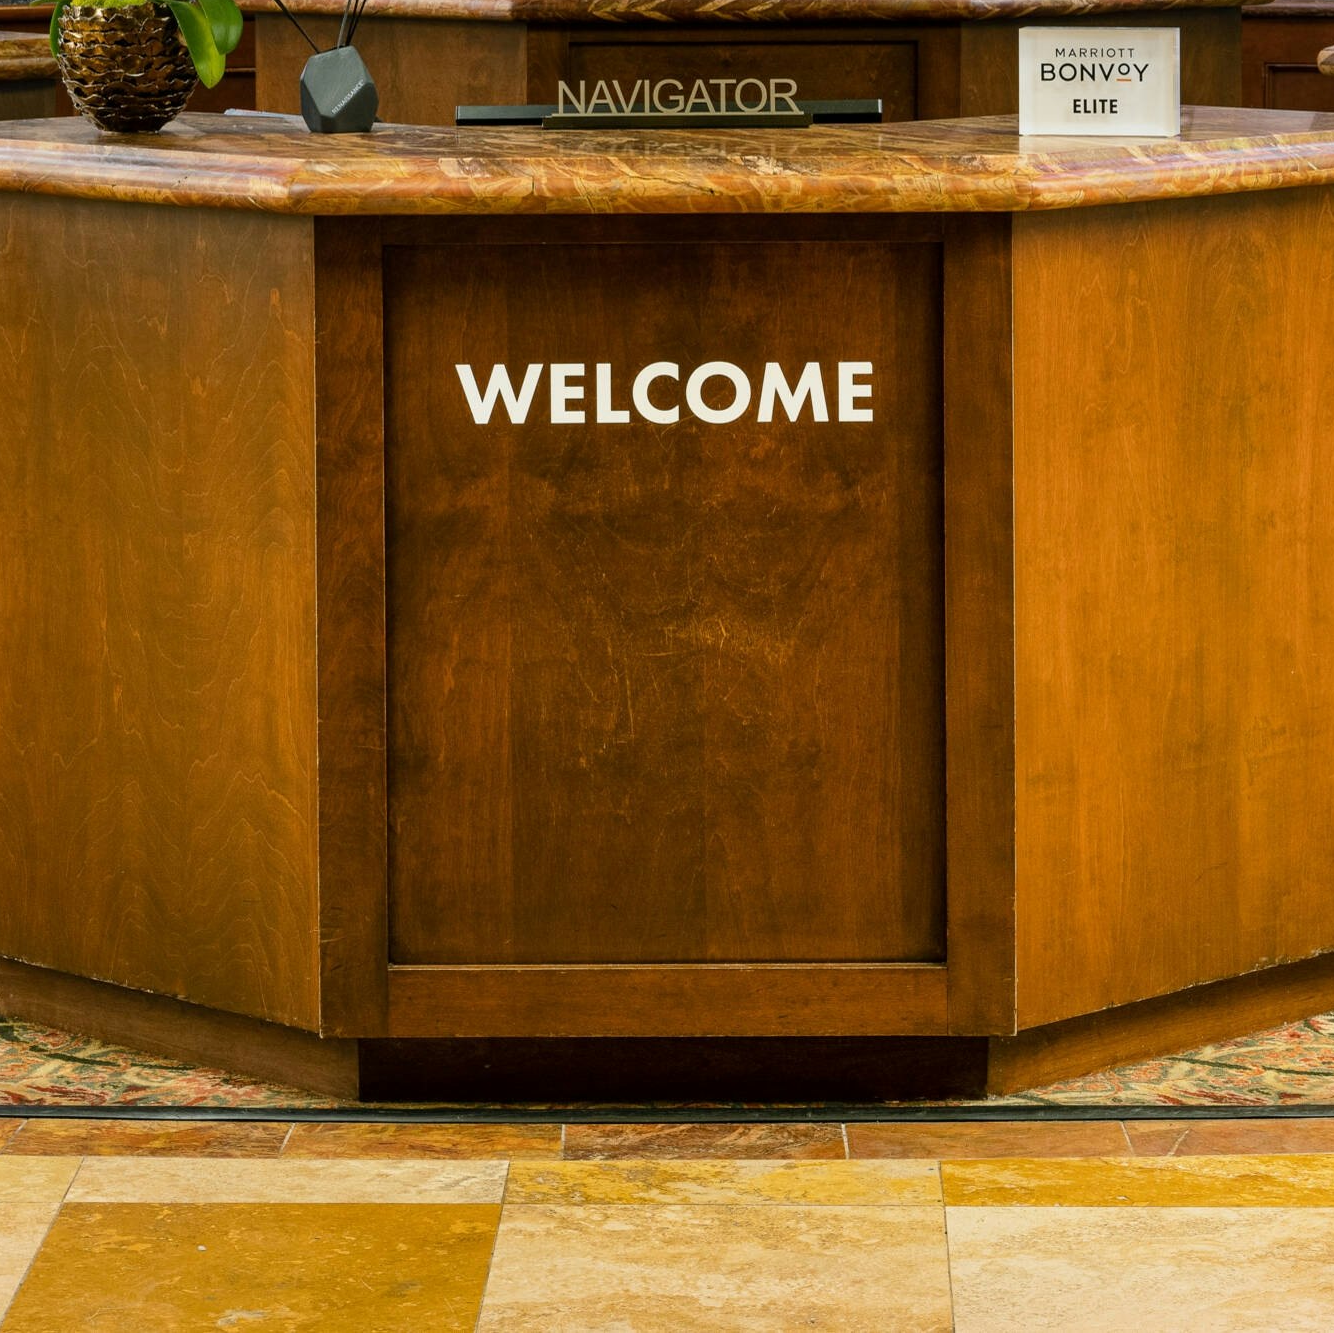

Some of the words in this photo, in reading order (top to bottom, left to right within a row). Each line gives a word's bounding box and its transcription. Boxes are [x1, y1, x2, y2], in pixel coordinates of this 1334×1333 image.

[1055, 47, 1135, 58] MARRIOTT
[1041, 63, 1149, 82] BONVOY
[558, 78, 799, 115] NAVIGATOR
[1073, 99, 1118, 114] ELITE
[456, 361, 874, 425] WELCOME
